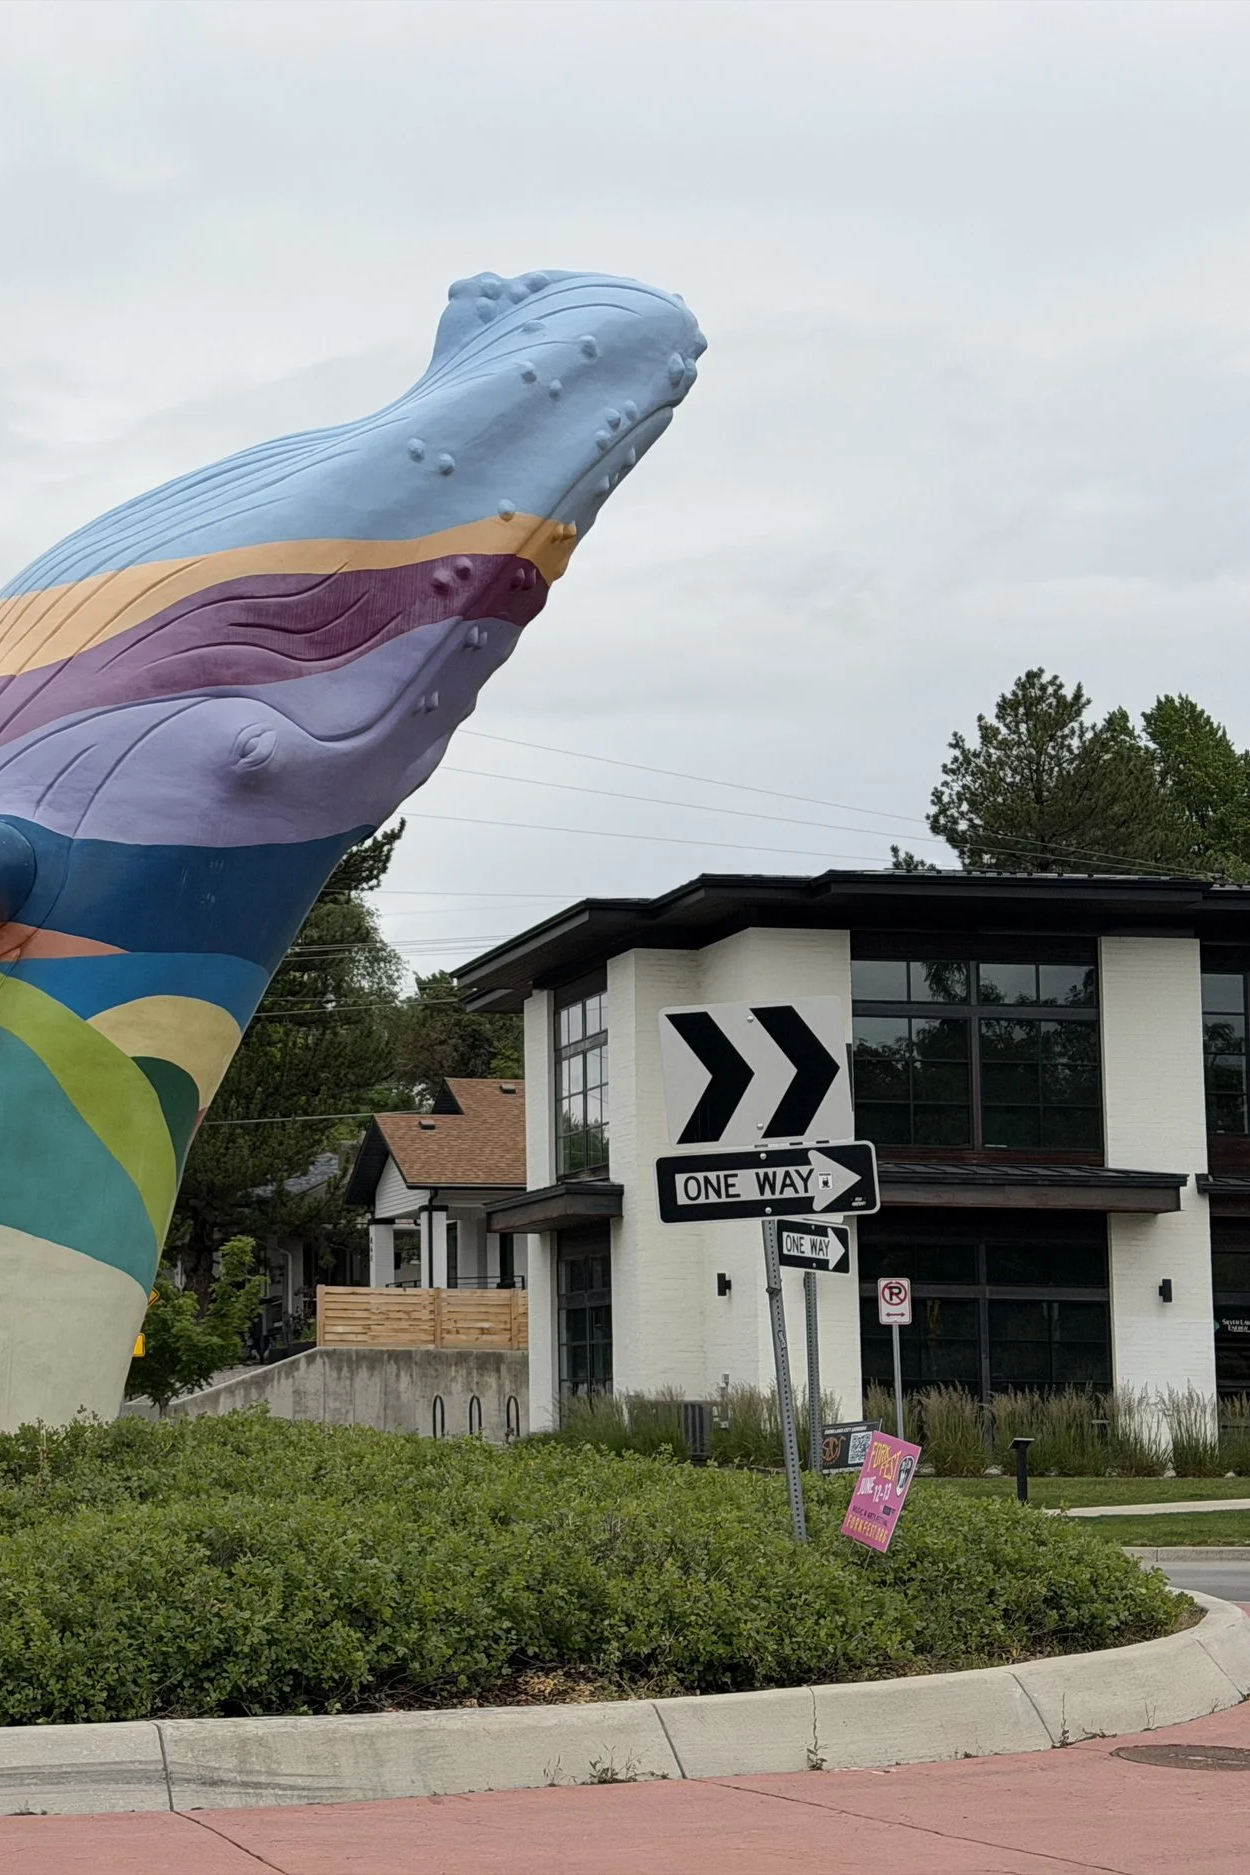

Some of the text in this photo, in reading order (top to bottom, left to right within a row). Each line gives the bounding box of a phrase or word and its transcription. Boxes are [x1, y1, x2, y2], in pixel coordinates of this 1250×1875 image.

[683, 1168, 815, 1201] ONE WAY
[786, 1234, 830, 1257] ONE WAY
[867, 1441, 891, 1472] FORK
[879, 1450, 902, 1481] FEST
[857, 1476, 876, 1495] JUNE
